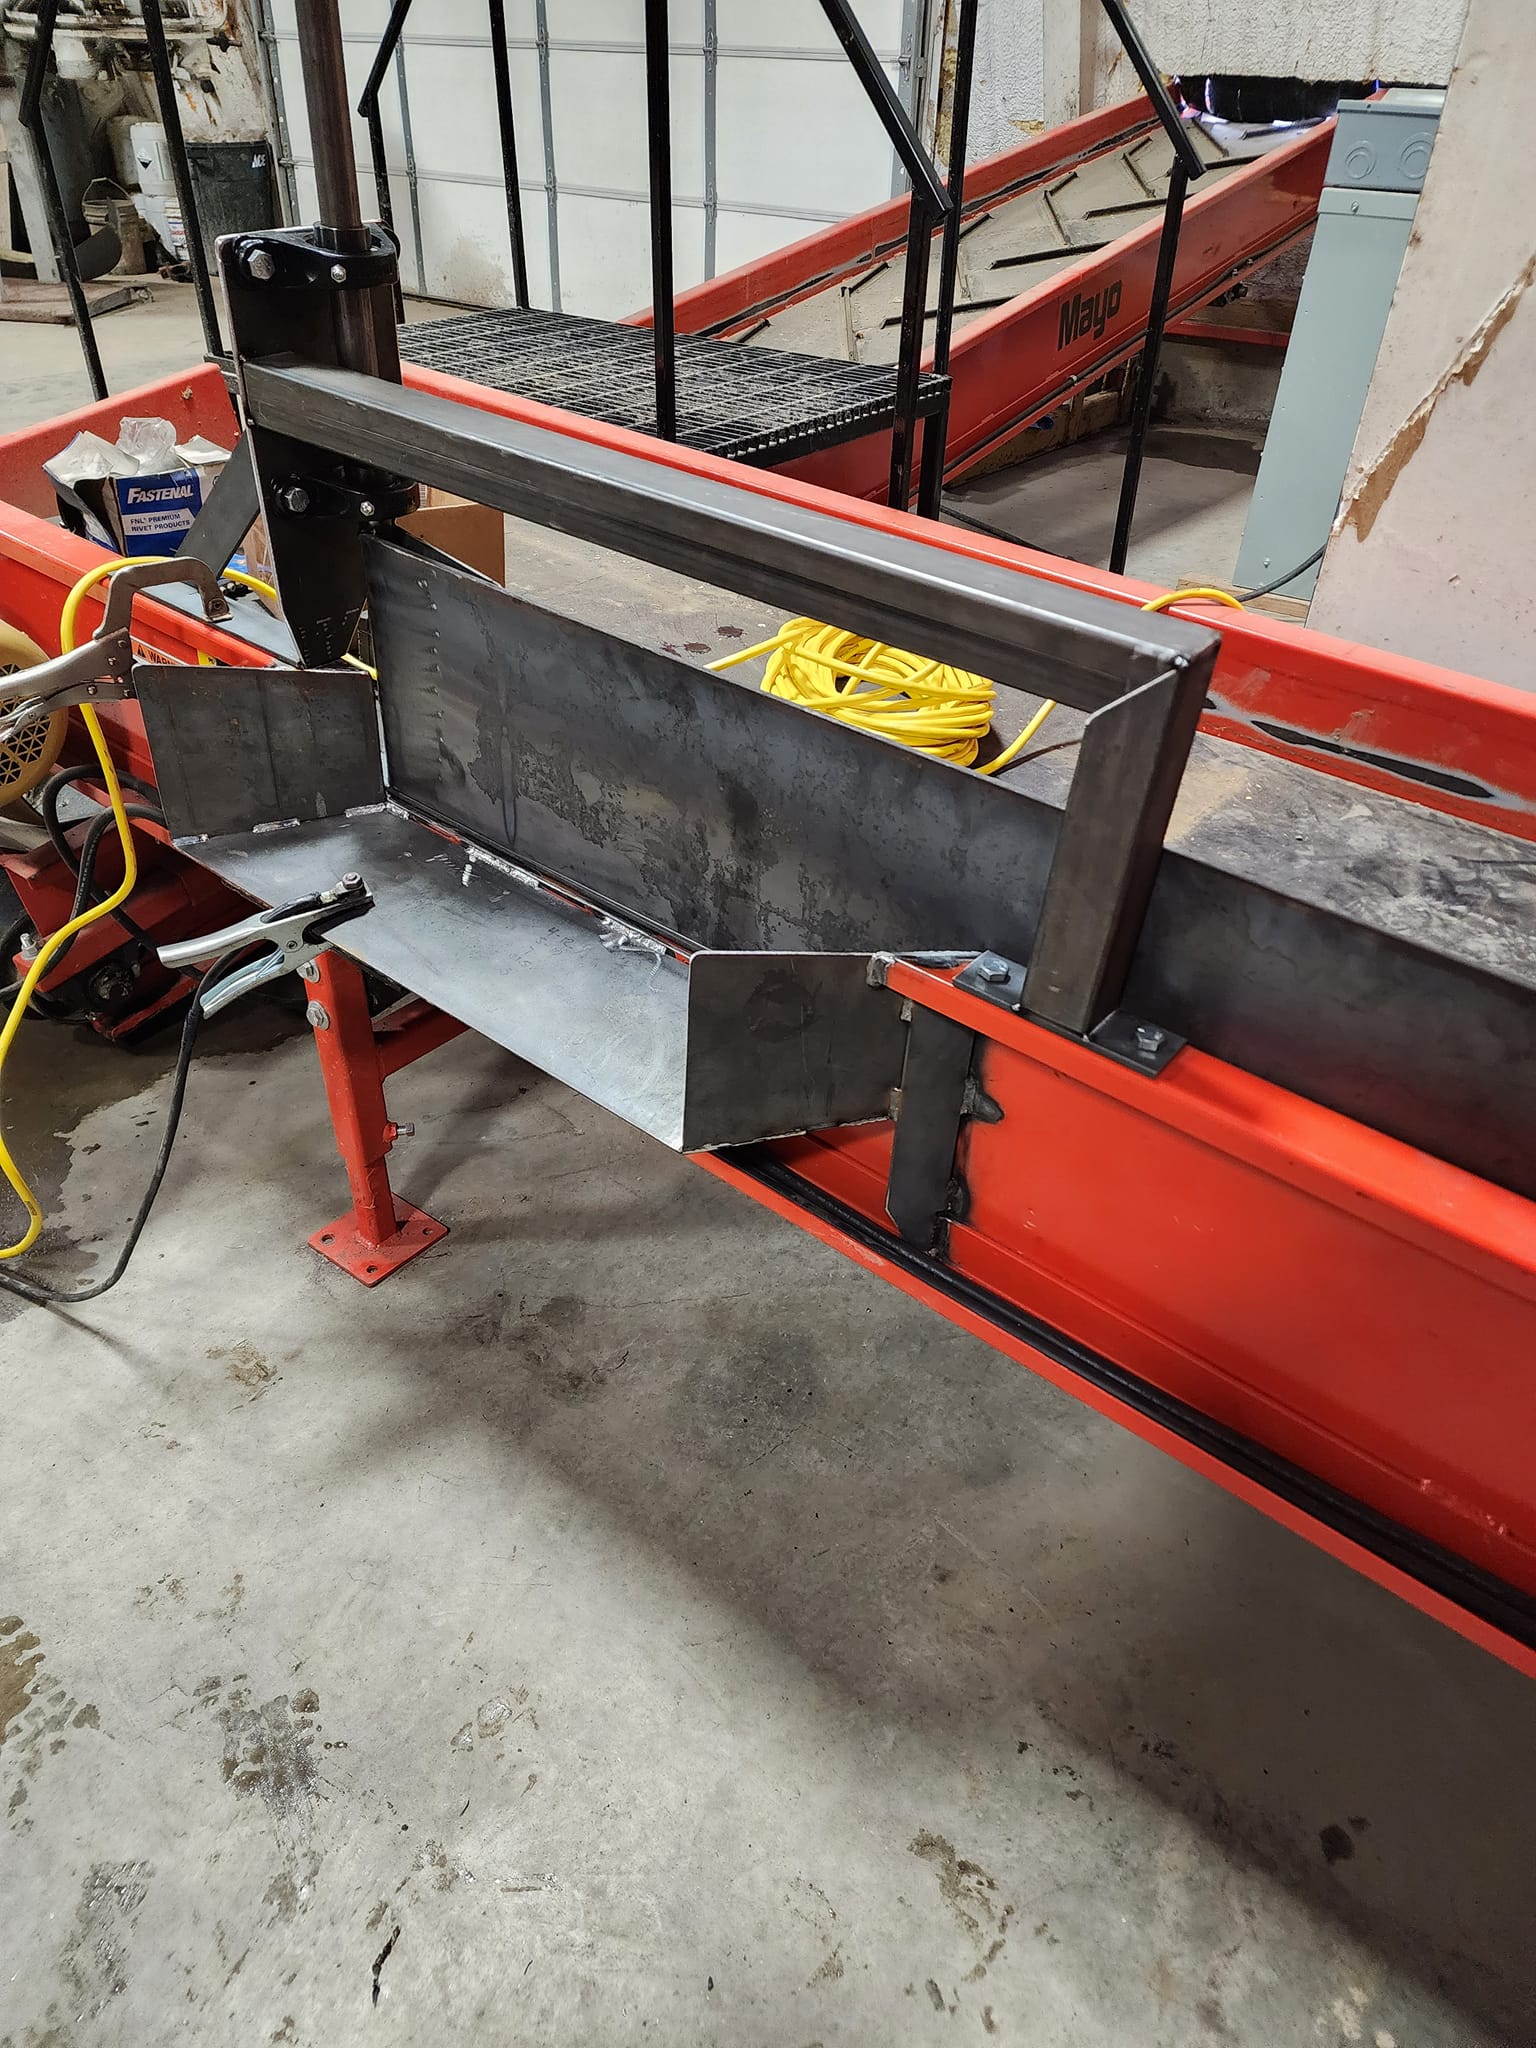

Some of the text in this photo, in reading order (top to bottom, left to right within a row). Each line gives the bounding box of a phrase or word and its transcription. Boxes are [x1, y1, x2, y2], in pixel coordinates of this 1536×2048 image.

[1057, 280, 1122, 352] Mayo
[127, 485, 194, 504] FASTENAL
[148, 513, 181, 523] PREMIUM
[154, 519, 190, 529] PRODUCTS
